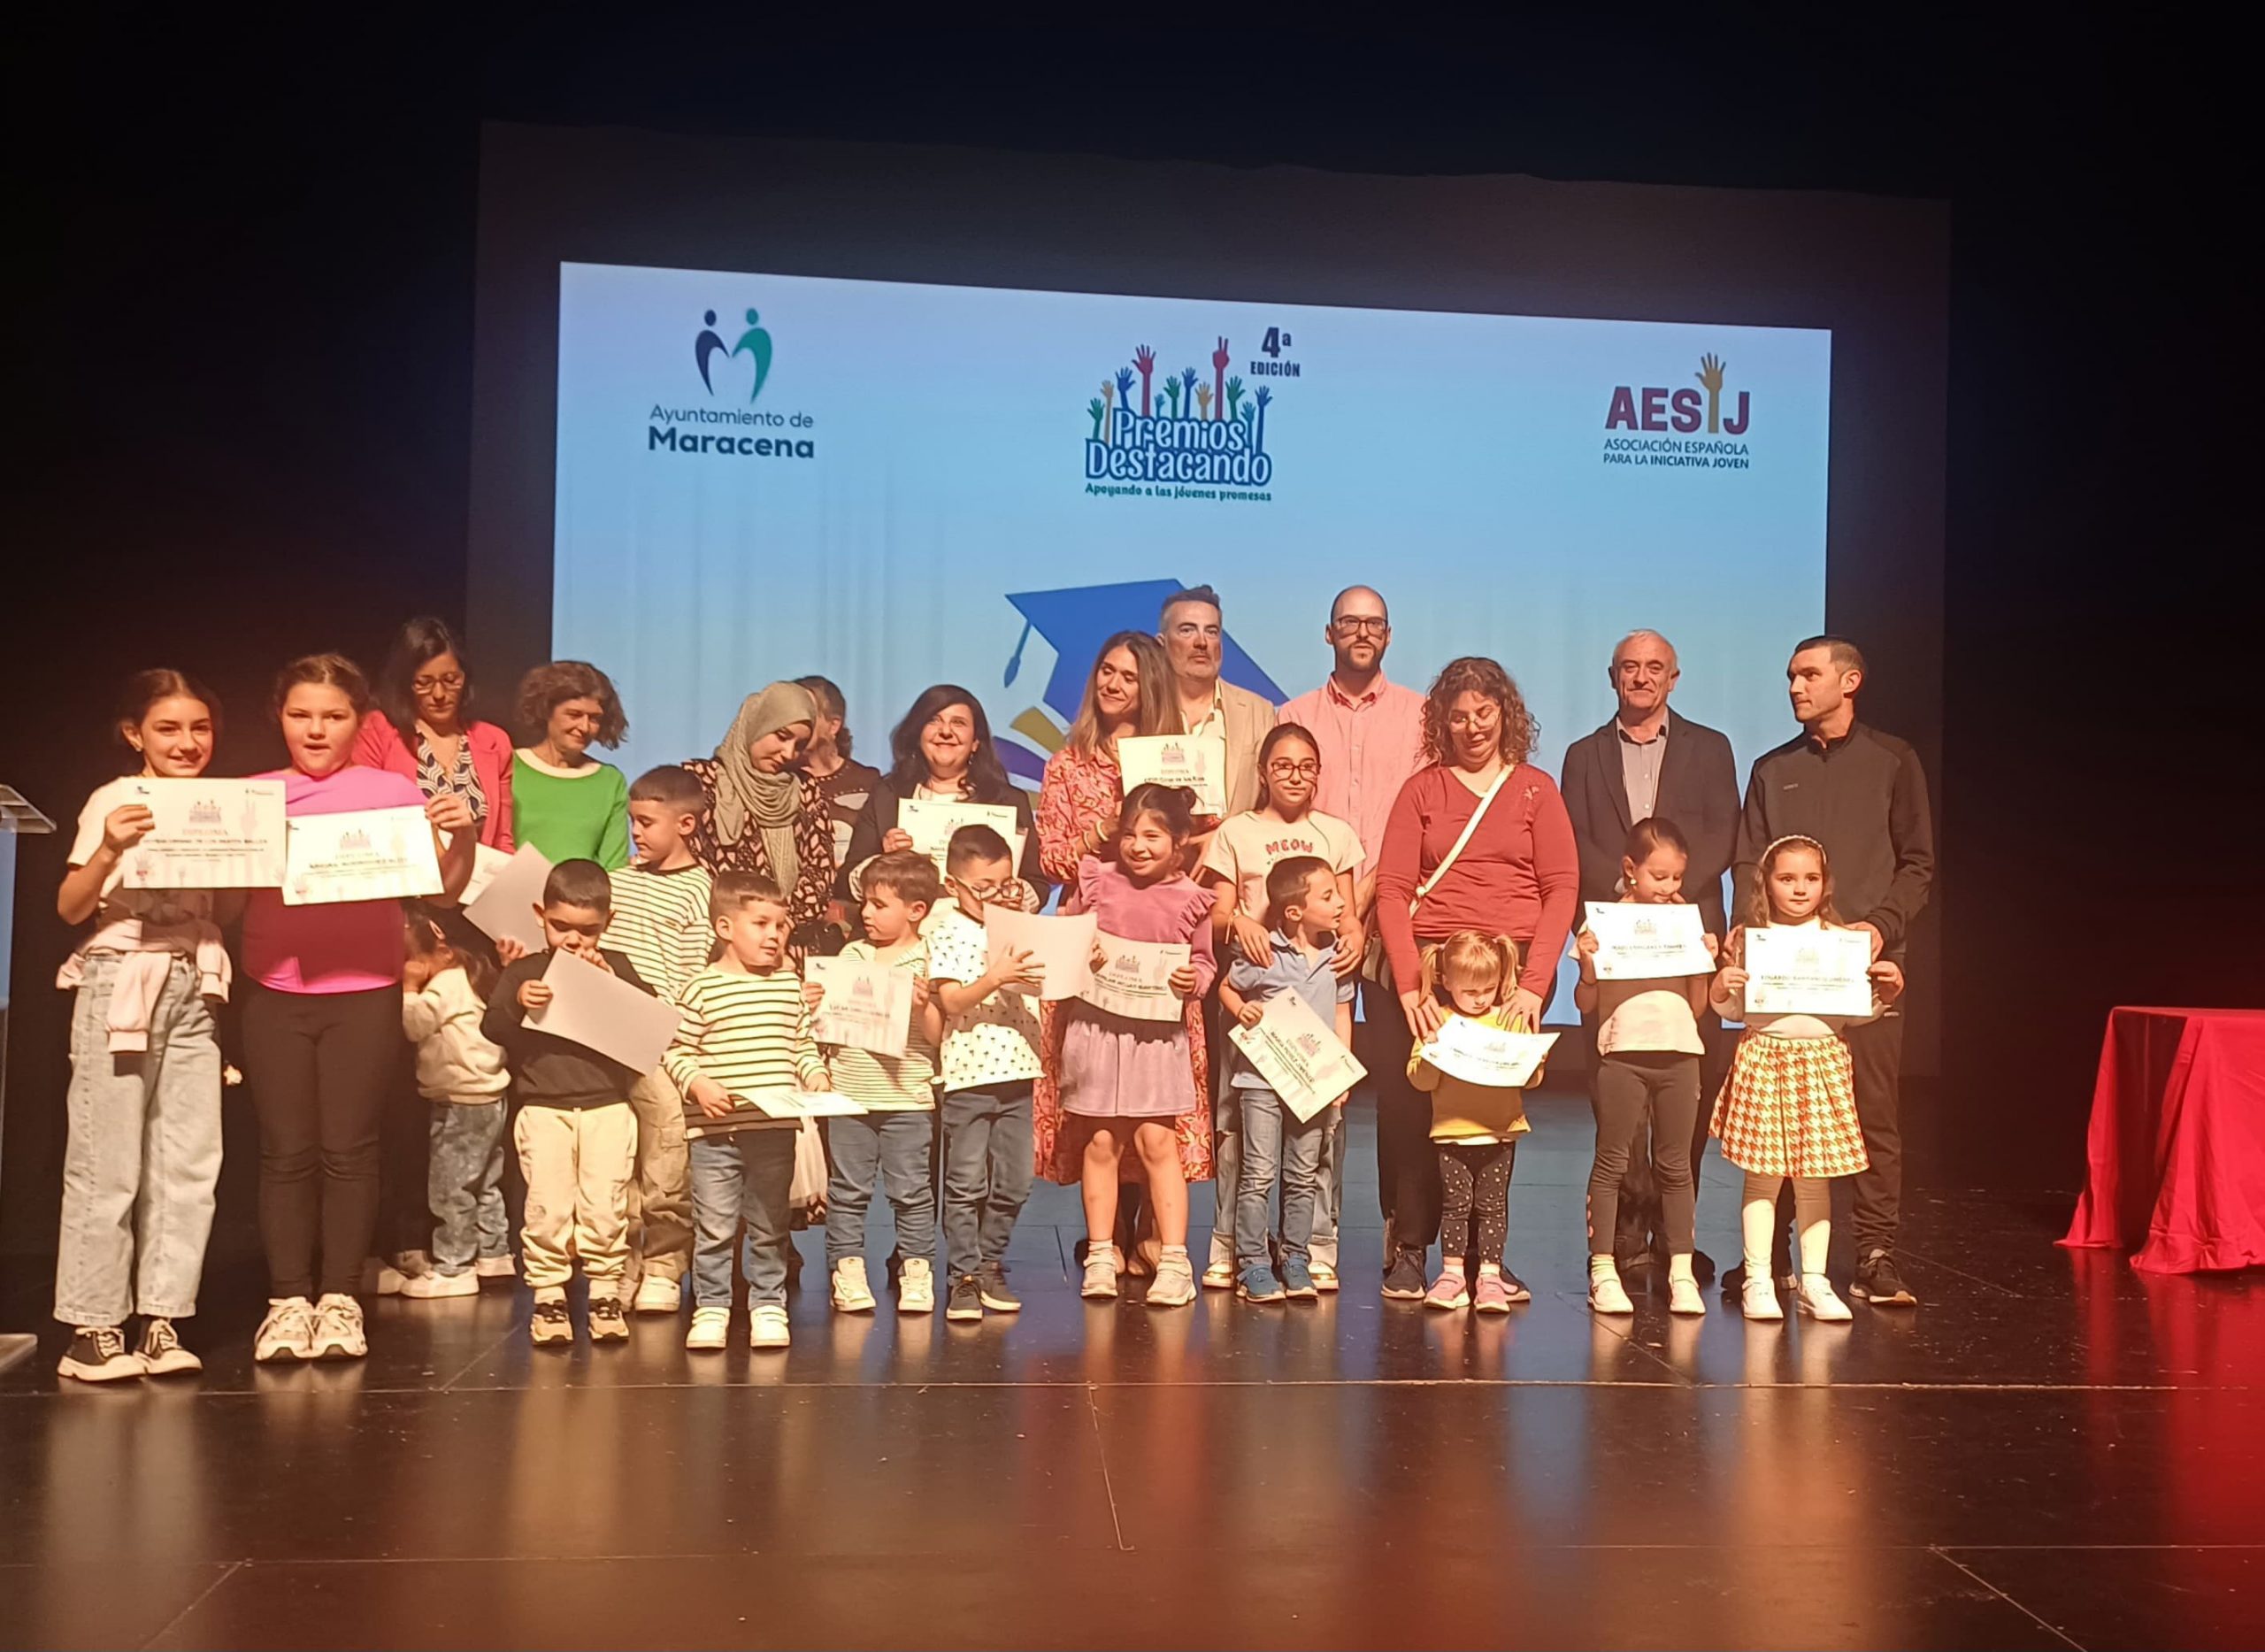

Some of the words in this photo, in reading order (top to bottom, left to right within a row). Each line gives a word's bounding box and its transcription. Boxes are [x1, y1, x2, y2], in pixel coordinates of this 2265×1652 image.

[1250, 360, 1301, 377] EDICIÓN
[649, 403, 785, 427] Ayuntamiento
[789, 411, 814, 428] de
[1112, 407, 1248, 453] Premios
[649, 426, 814, 458] Maracena
[1604, 437, 1682, 453] ASOCIACIÓN
[1684, 441, 1748, 456] ESPAÑOLA
[1086, 439, 1272, 487] Destacando
[1603, 453, 1632, 465] PARA
[1635, 454, 1648, 465] LA
[1650, 455, 1709, 468] INICIATIVA
[1712, 457, 1749, 469] JOVEN
[1085, 482, 1142, 497] Apoyando
[1145, 487, 1153, 496] a
[1156, 486, 1171, 497] las
[1174, 486, 1217, 500] jóvenes
[1219, 489, 1272, 502] promesas
[1265, 838, 1313, 855] MEOW
